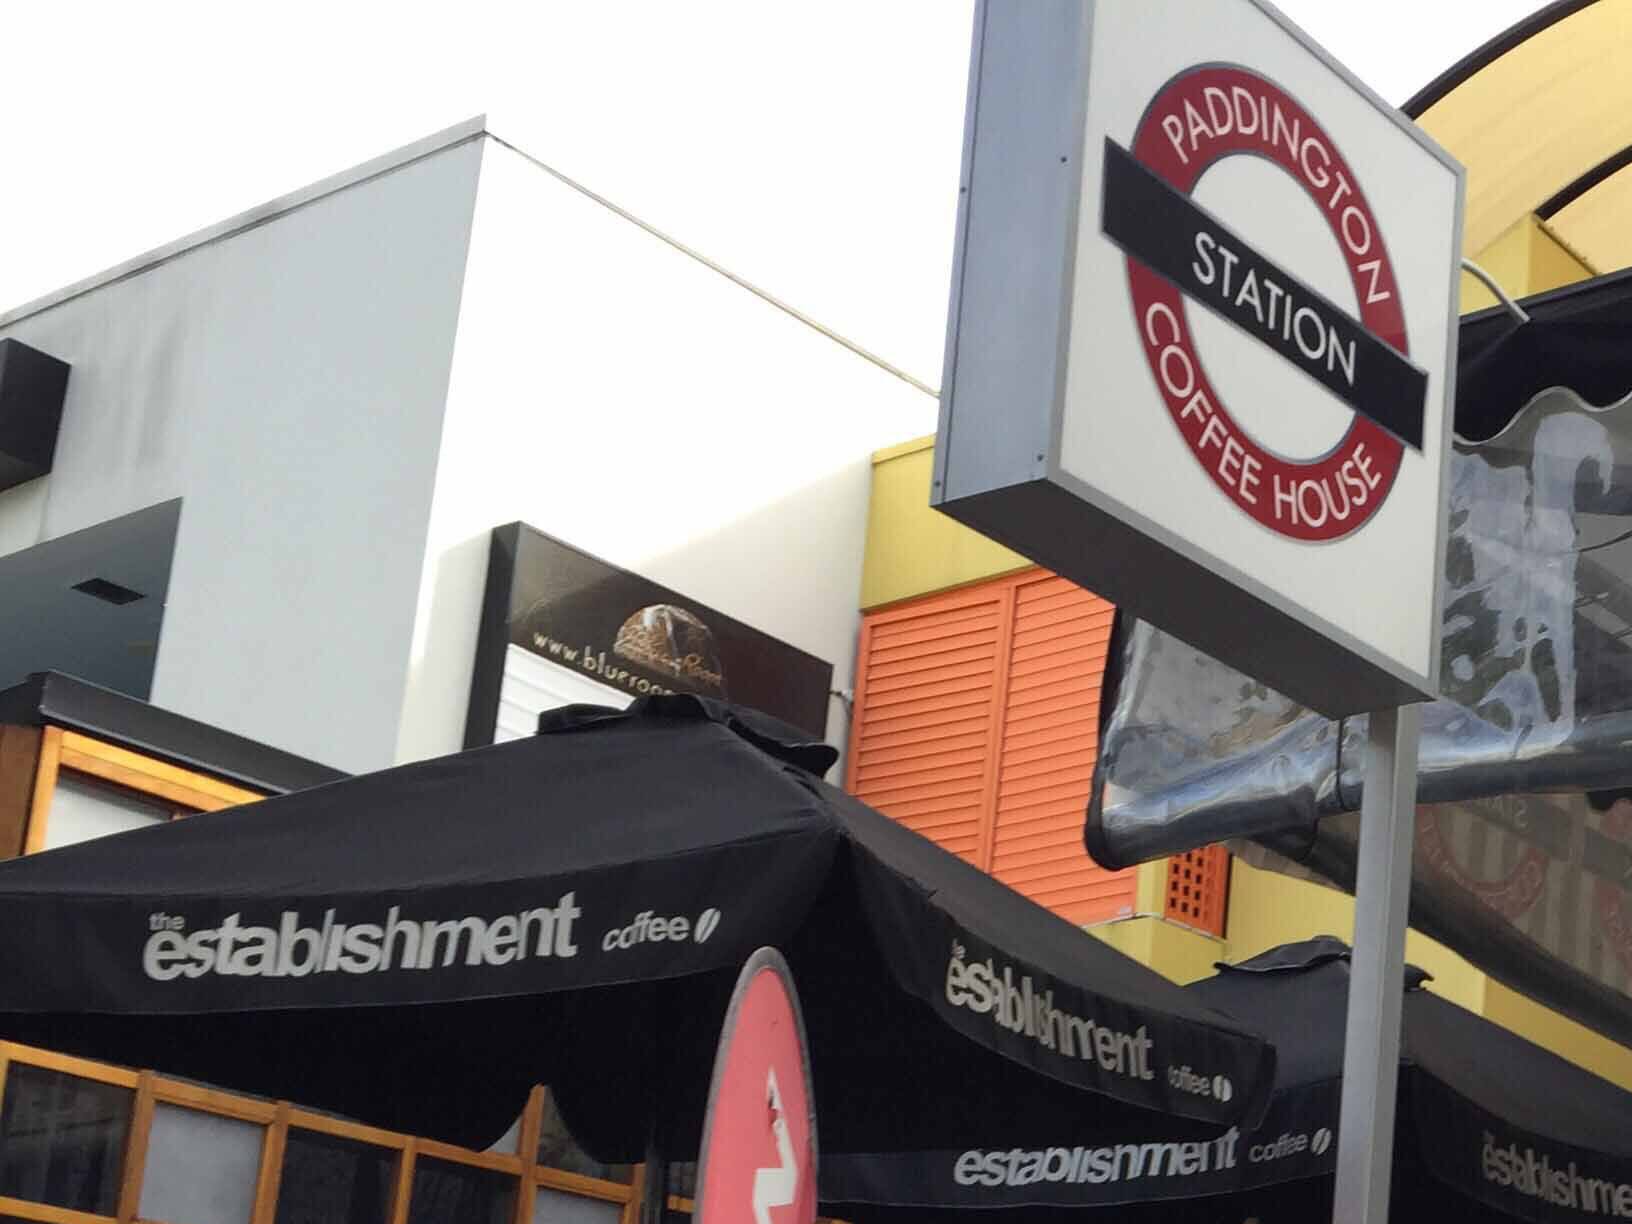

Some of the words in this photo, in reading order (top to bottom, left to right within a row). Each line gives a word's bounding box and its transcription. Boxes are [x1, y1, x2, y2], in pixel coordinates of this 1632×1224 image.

[1162, 85, 1391, 304] PADDINGTON
[1193, 232, 1356, 385] STATION
[1146, 301, 1260, 504] COFFEE
[1274, 442, 1382, 528] HOUSE
[142, 891, 582, 982] establishment
[601, 909, 690, 953] coffee
[149, 911, 185, 931] the
[1248, 1131, 1309, 1163] coffee
